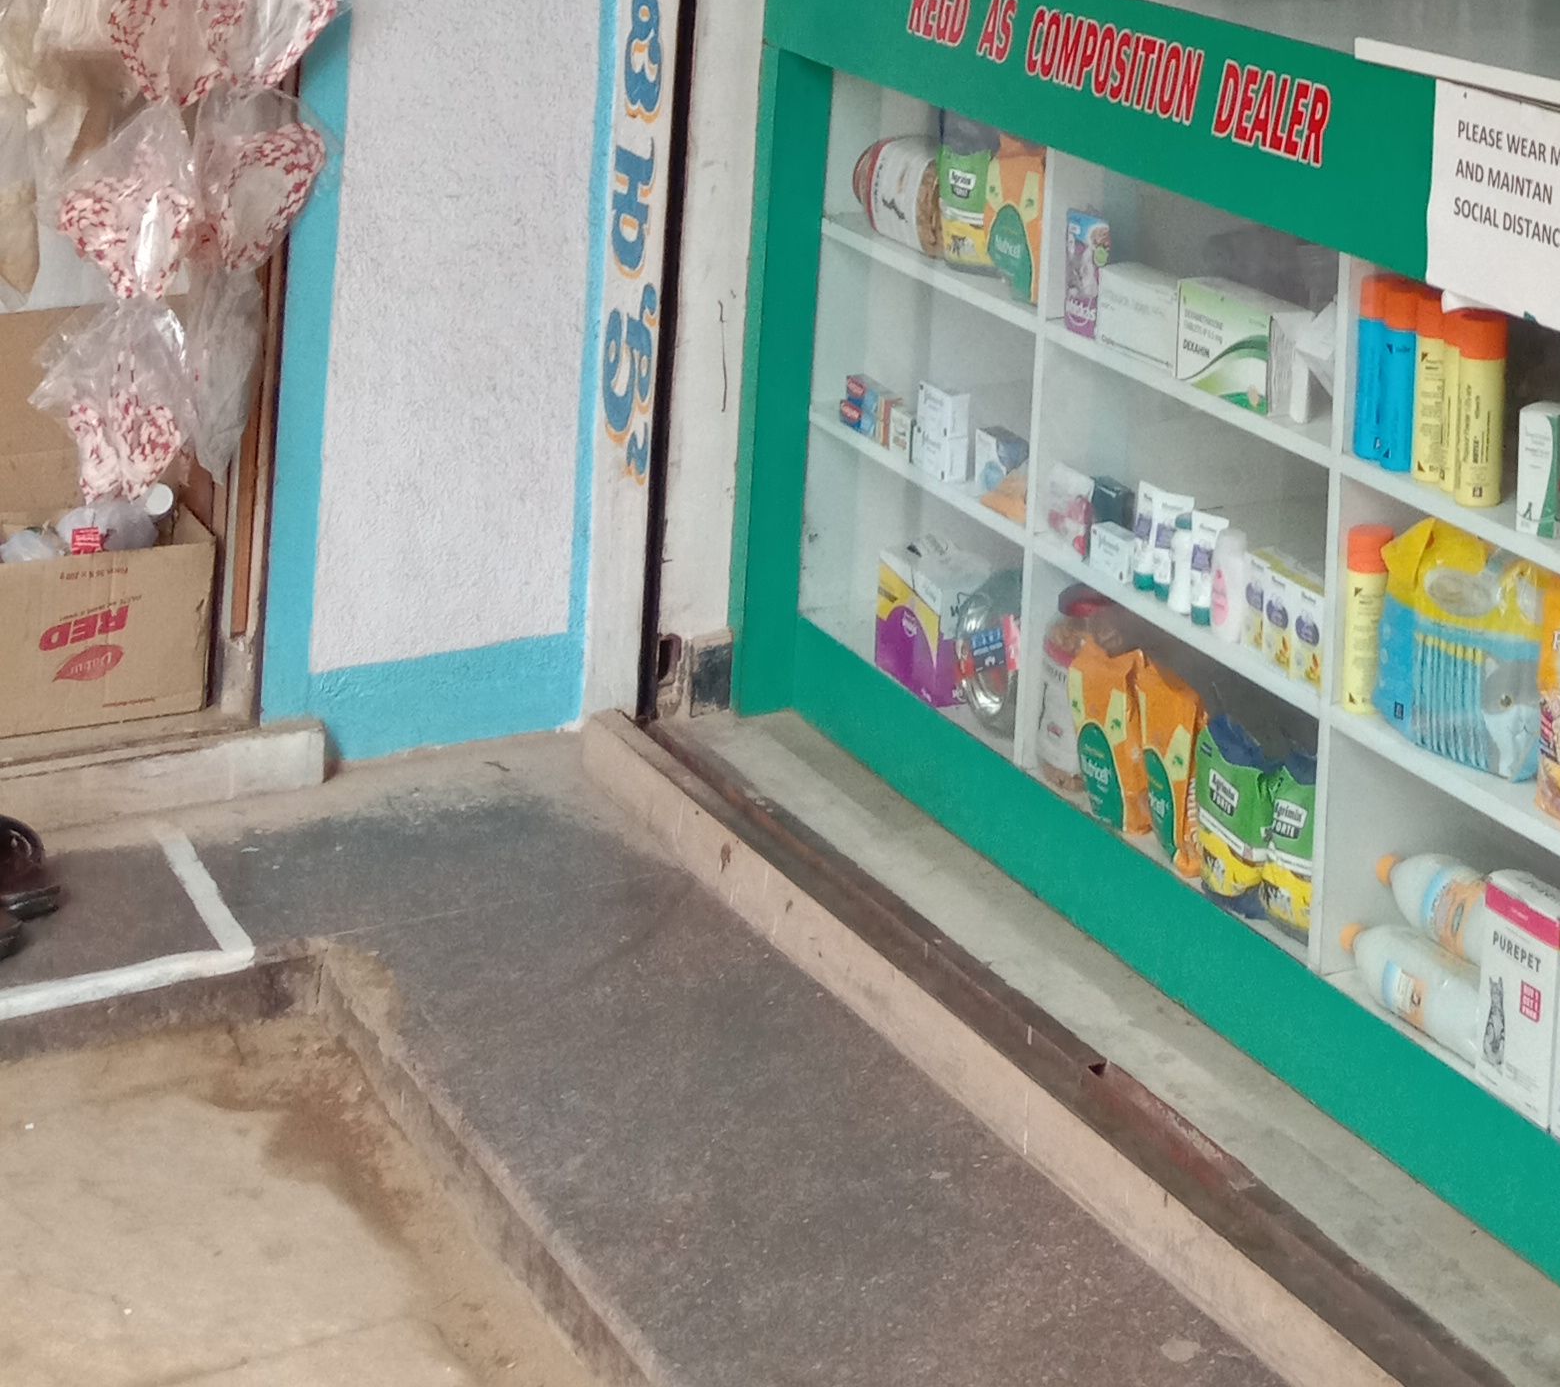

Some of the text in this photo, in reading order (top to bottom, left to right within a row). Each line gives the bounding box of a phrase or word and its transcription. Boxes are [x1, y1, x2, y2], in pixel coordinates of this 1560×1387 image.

[1025, 6, 1204, 126] COMPOSITION
[1212, 59, 1332, 168] DEALER
[1456, 118, 1503, 151] PLEASE
[1506, 132, 1547, 164] WEAR
[1454, 157, 1485, 184] AND
[1452, 195, 1500, 230] SOCIAL
[38, 605, 130, 652] RED
[1491, 929, 1542, 974] PUREPET
